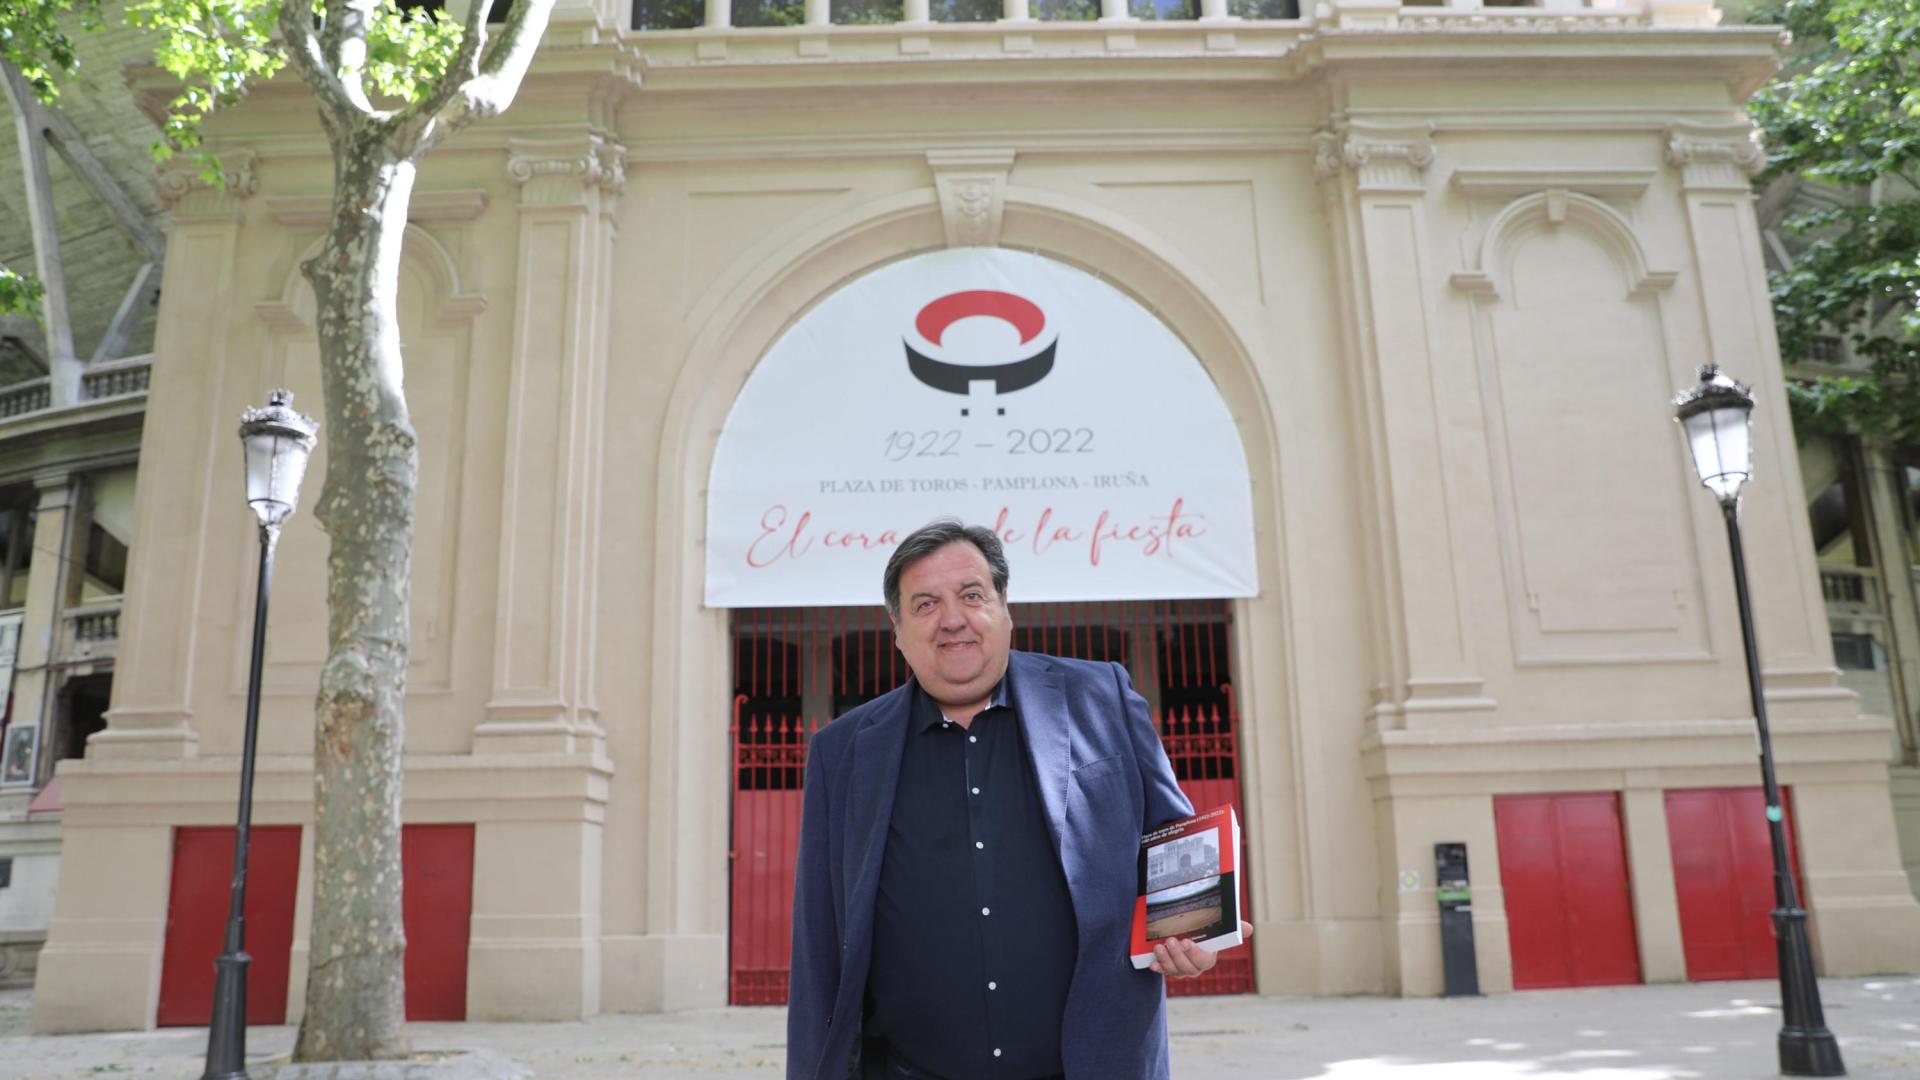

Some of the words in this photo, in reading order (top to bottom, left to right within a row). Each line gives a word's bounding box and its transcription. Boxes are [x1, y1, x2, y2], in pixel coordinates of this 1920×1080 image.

[884, 430, 962, 462] 1922
[1007, 427, 1095, 455] 2022
[819, 479, 876, 494] PLAZA
[880, 478, 904, 493] DE
[909, 478, 969, 493] TOROS
[982, 475, 1080, 491] PAMPLONA
[1093, 470, 1150, 489] IRUÑA
[746, 504, 816, 569] El
[823, 528, 902, 550] cora
[1032, 507, 1083, 556] la
[1090, 497, 1207, 567] fiesta
